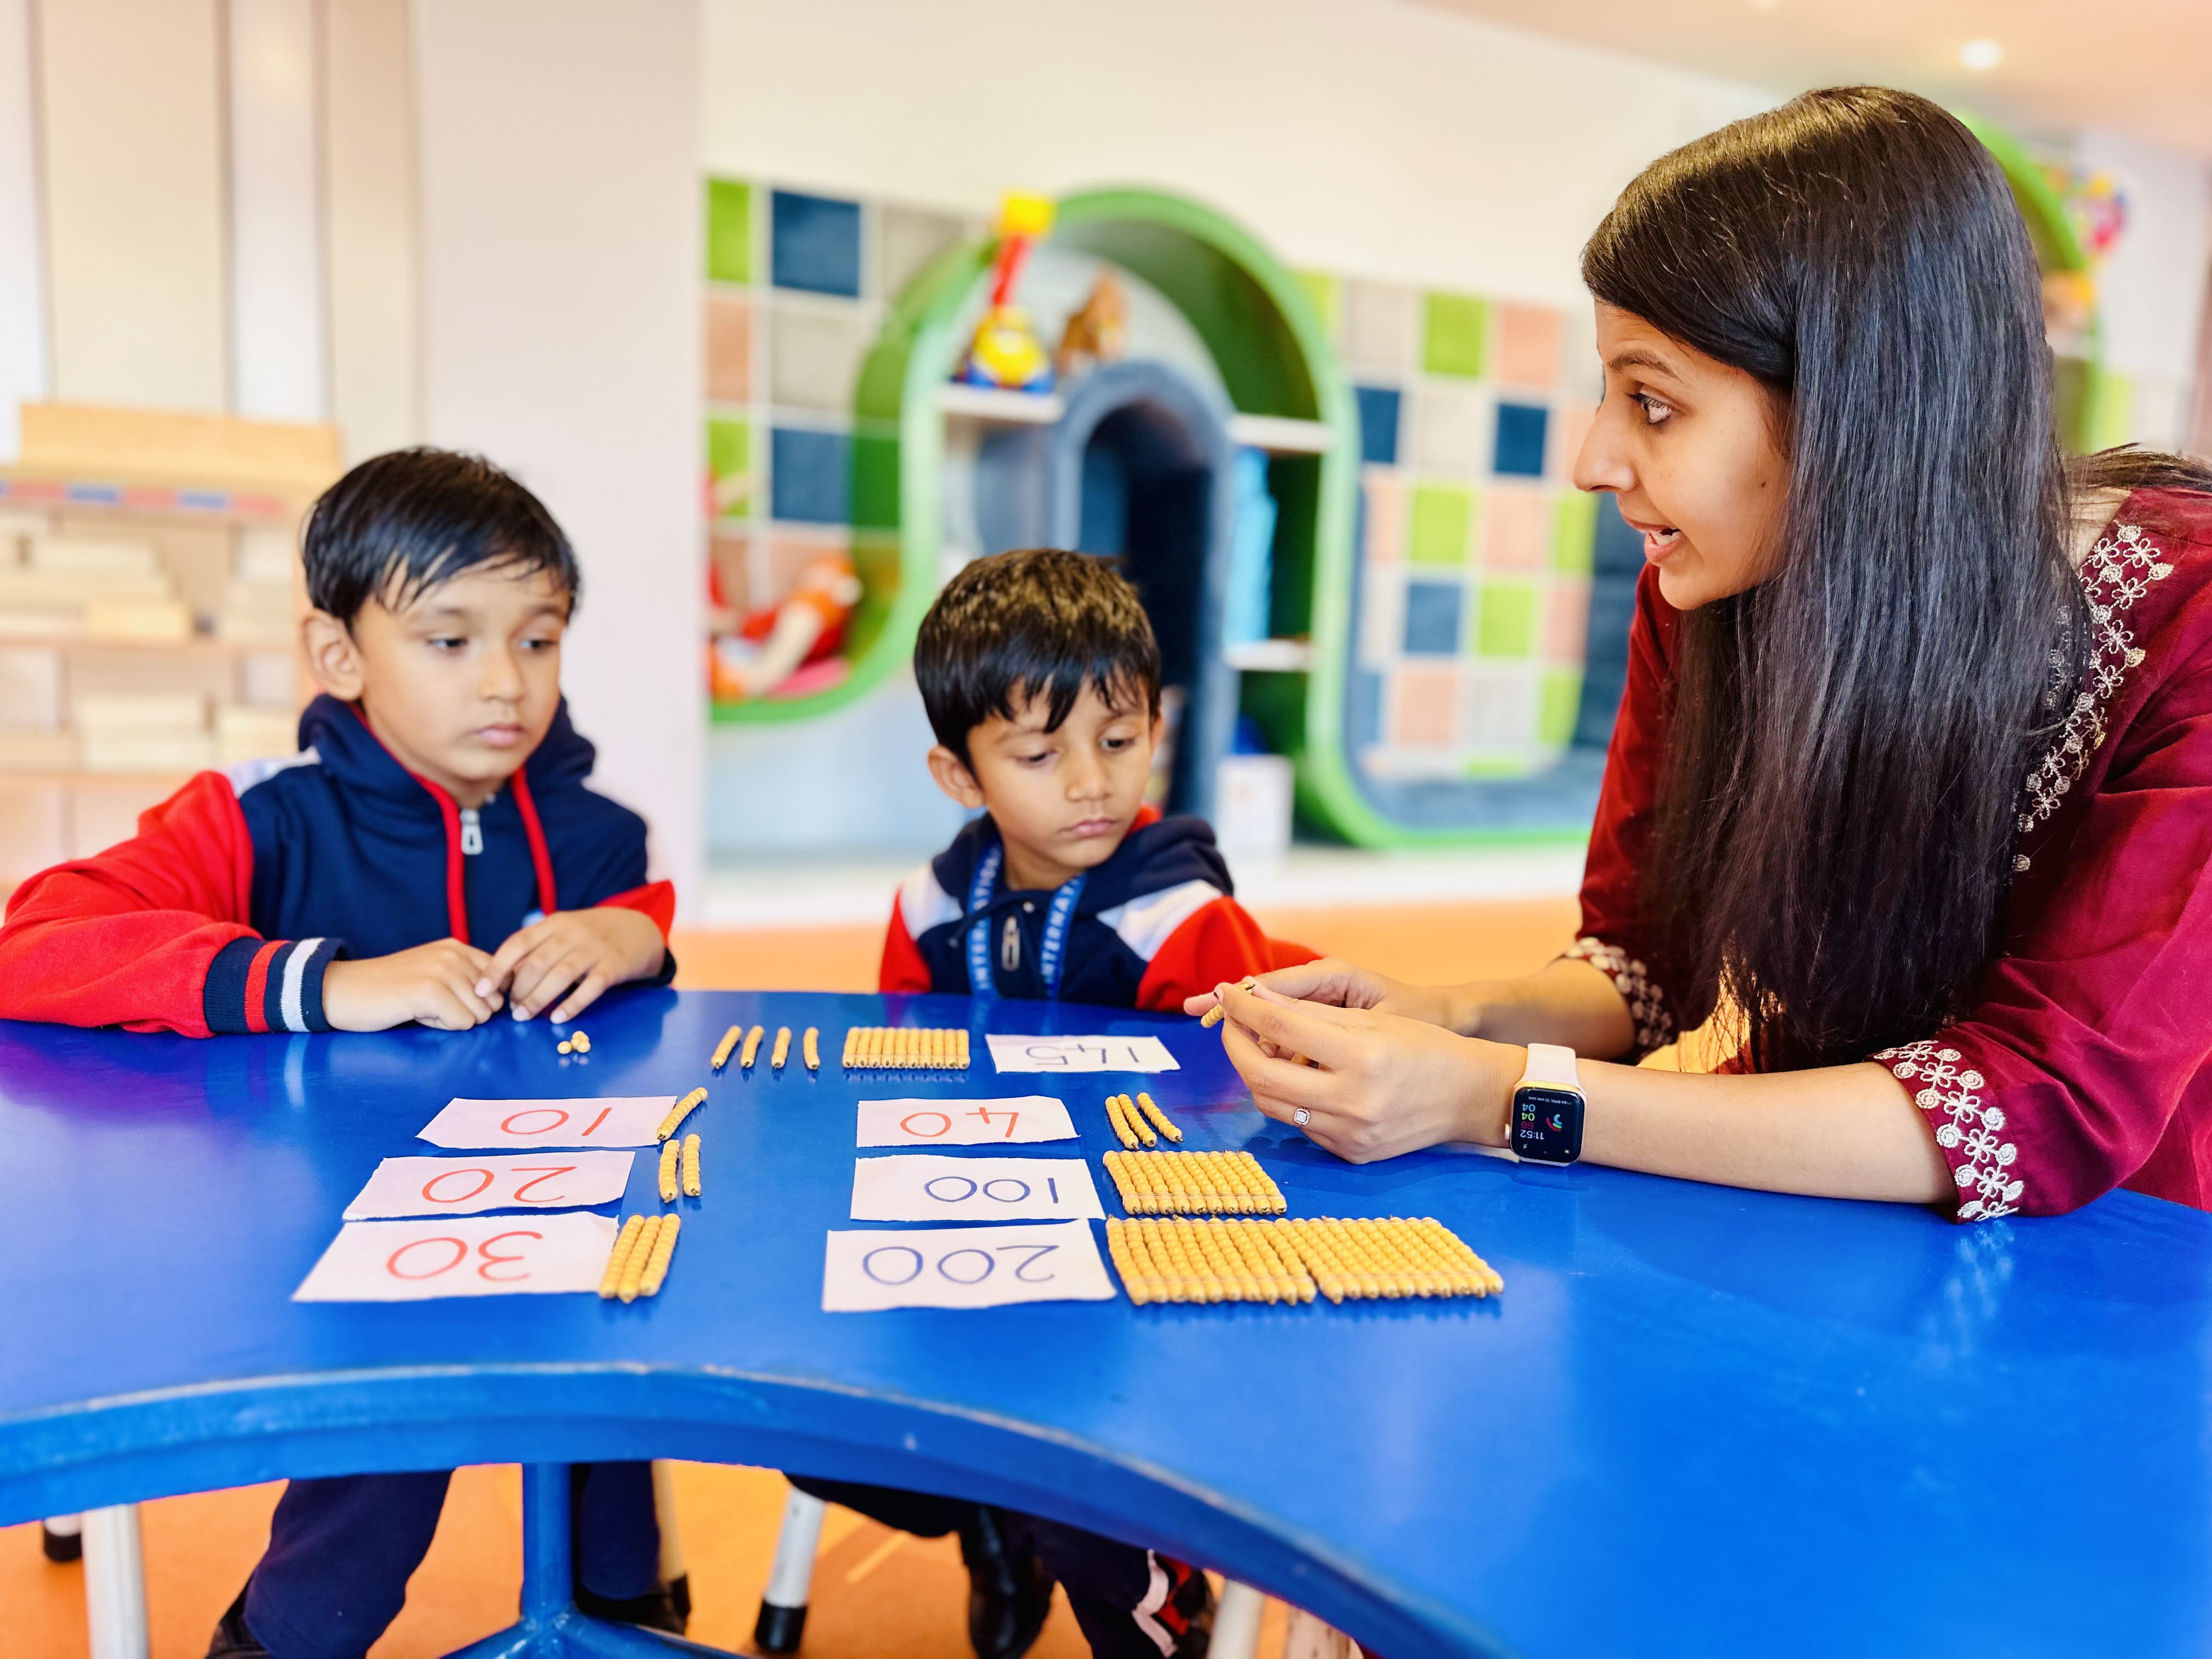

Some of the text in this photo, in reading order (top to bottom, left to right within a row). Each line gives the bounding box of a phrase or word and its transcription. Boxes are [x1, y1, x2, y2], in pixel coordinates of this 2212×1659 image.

[1026, 1044, 1139, 1065] 145
[1521, 1112, 1535, 1121] 04
[1522, 1103, 1536, 1112] 04
[500, 1107, 612, 1136] 10
[900, 1107, 1019, 1137] 40
[1520, 1129, 1544, 1140] 11:52
[1521, 1121, 1533, 1130] 66
[421, 1166, 577, 1203] 20
[924, 1177, 1059, 1203] 100
[386, 1231, 543, 1282] 30
[862, 1245, 1059, 1285] 200
